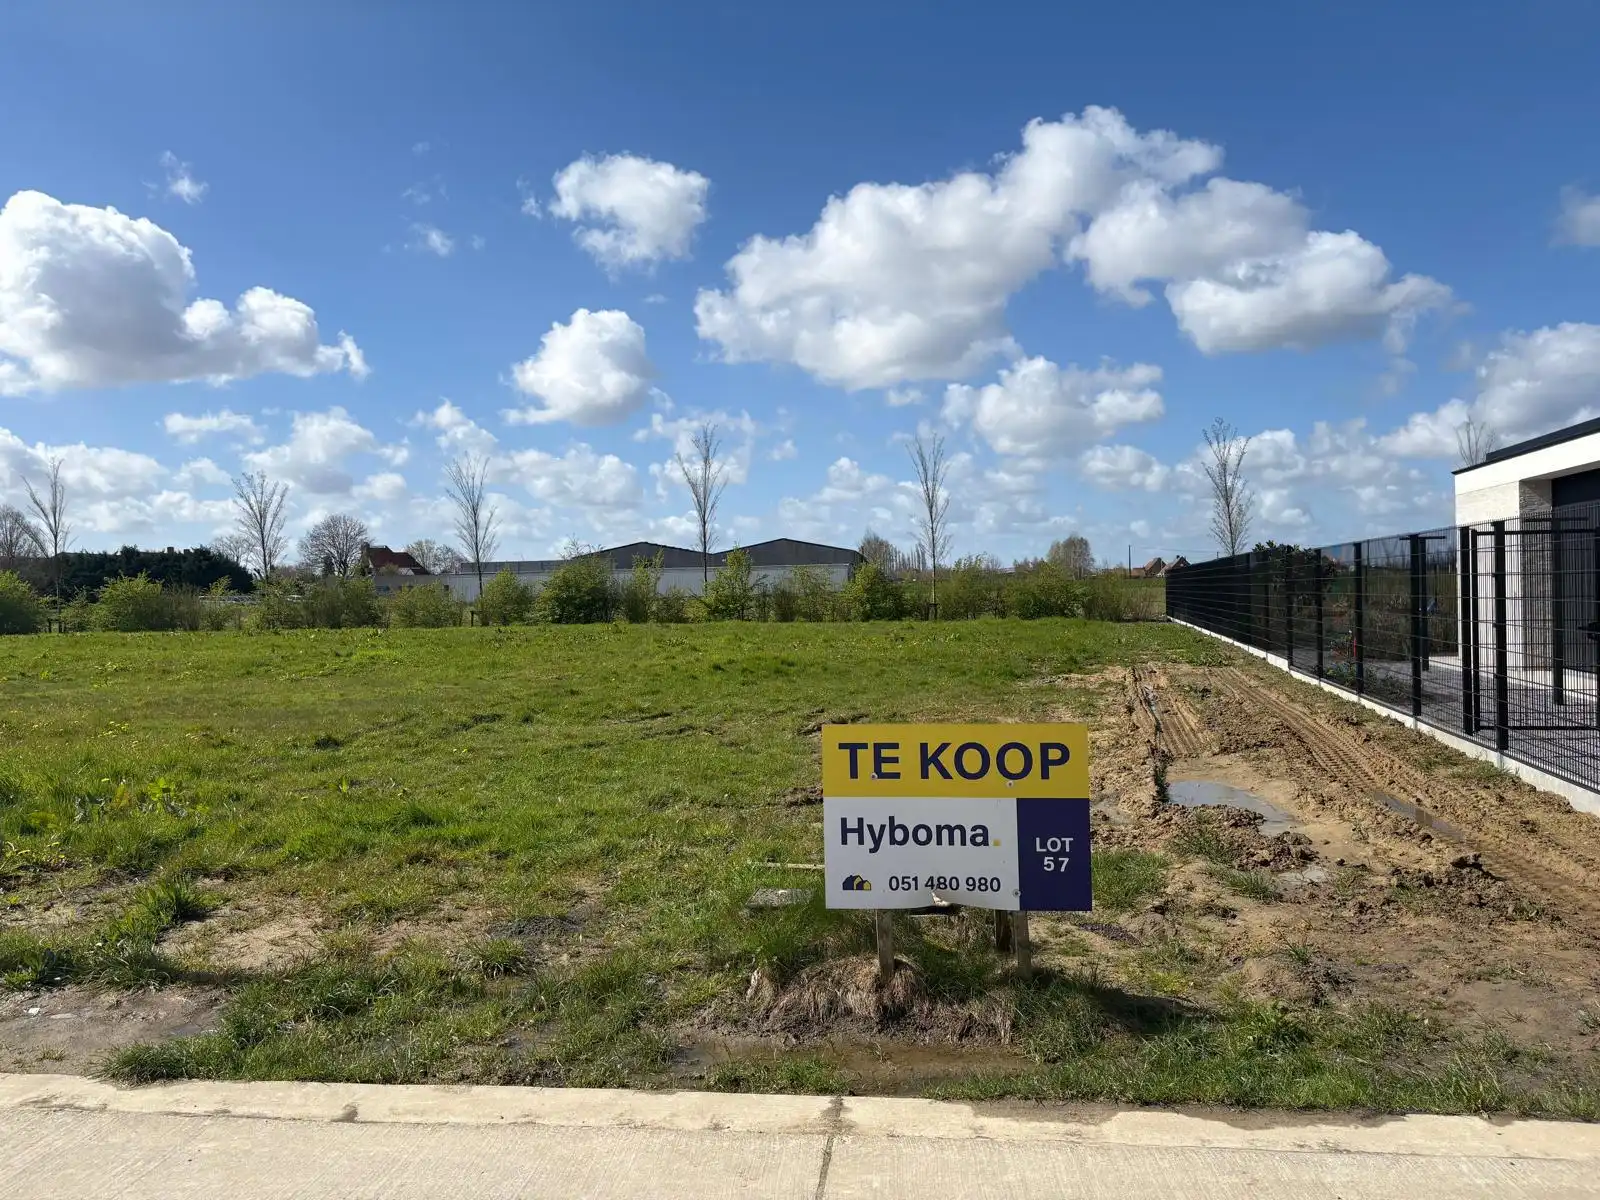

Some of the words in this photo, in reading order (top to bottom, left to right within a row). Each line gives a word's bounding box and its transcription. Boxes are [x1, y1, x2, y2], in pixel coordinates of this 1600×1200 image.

[838, 742, 901, 780] TE
[920, 742, 1071, 780] KOOP
[1035, 837, 1074, 852] LOT
[1043, 856, 1070, 872] 57
[888, 876, 919, 891] 051
[924, 876, 960, 891] 480
[966, 877, 1001, 892] 980
